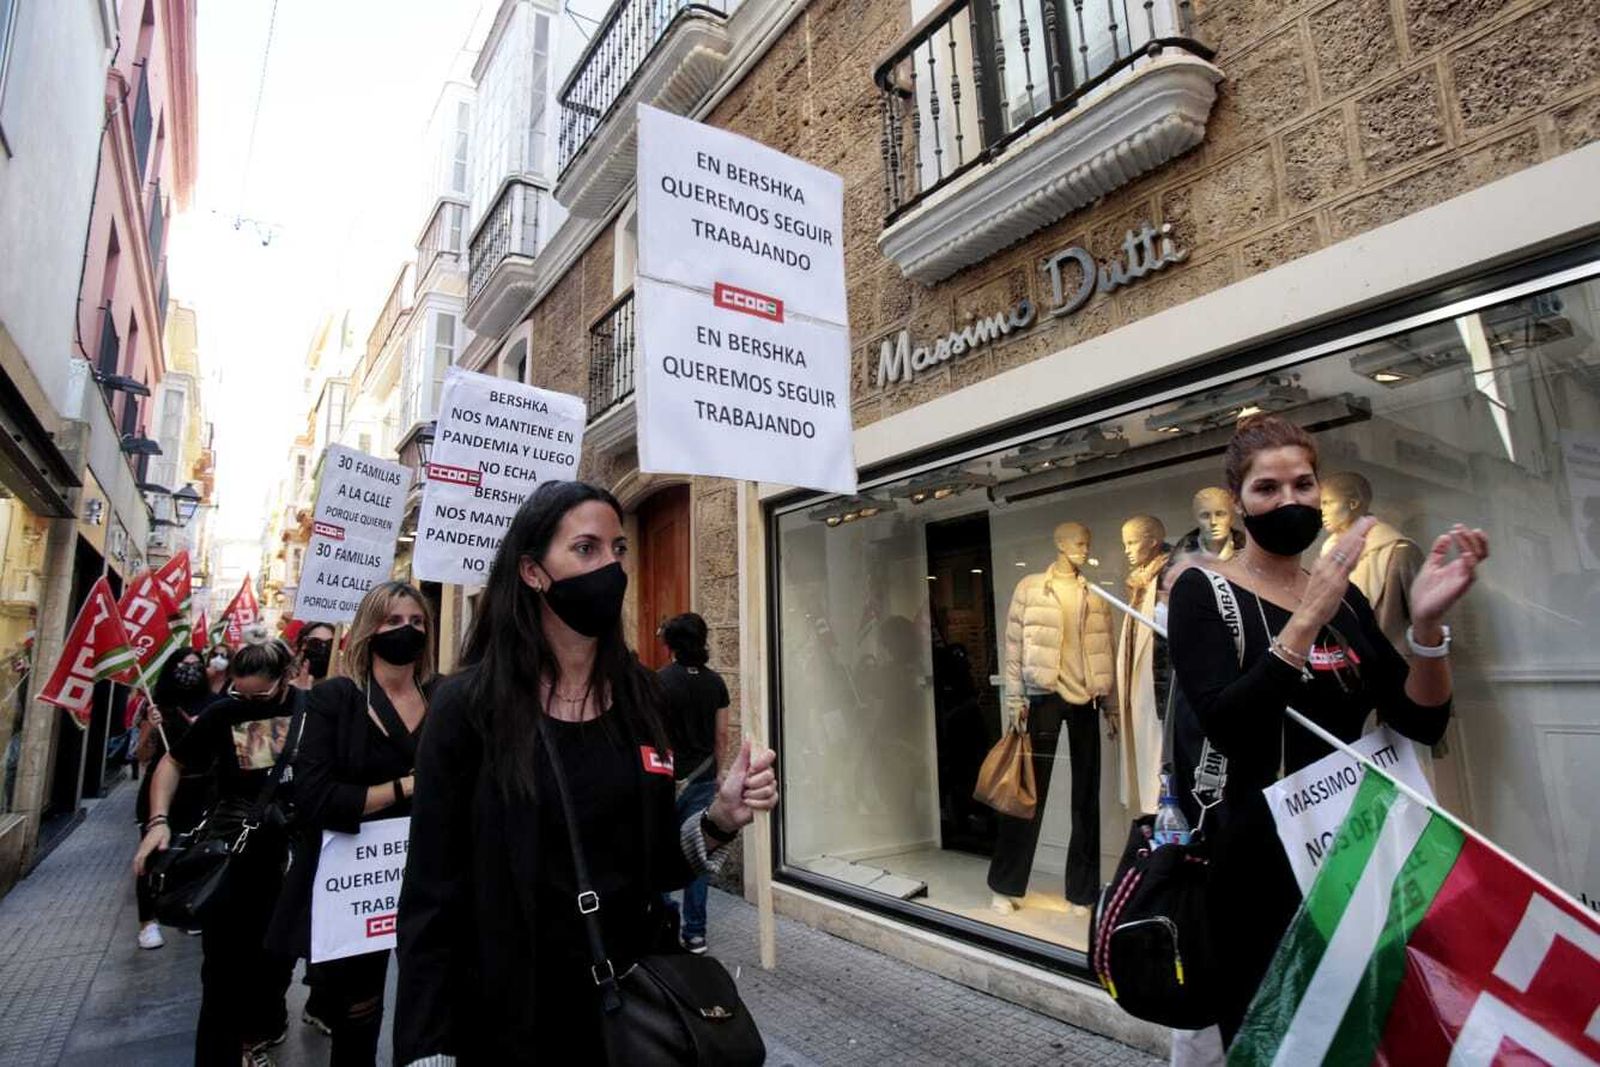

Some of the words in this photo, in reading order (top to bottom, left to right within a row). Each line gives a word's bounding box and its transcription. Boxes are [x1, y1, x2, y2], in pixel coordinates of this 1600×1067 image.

[697, 152, 720, 175] EN
[727, 163, 805, 205] BERSHKA
[661, 175, 769, 225] QUEREMOS
[774, 213, 832, 246] SEGUIR
[692, 219, 811, 271] TRABAJANDO
[876, 298, 1037, 387] Massimo
[1043, 222, 1190, 318] Dutti
[697, 326, 721, 348] EN
[728, 333, 807, 368] BERSHKA
[663, 356, 772, 395] QUEREMOS
[777, 380, 836, 408] SEGUIR
[490, 390, 548, 414] BERSHKA
[451, 407, 481, 424] NOS
[486, 414, 554, 439] MANTIENE
[557, 430, 574, 444] EN
[694, 400, 816, 439] TRABAJANDO
[442, 429, 518, 456] PANDEMIA
[522, 445, 531, 457] Y
[533, 449, 575, 466] LUEGO
[338, 455, 353, 470] 30
[356, 462, 401, 486] FAMILIAS
[478, 460, 500, 475] NO
[504, 465, 537, 481] ECHA
[338, 483, 346, 497] A
[349, 486, 361, 501] LA
[363, 490, 392, 508] CALLE
[474, 486, 526, 505] BERSHK
[326, 505, 359, 522] PORQUE
[360, 513, 393, 530] QUIEREN
[435, 505, 466, 521] NOS
[470, 510, 512, 528] MANT
[316, 542, 332, 558] 30
[335, 548, 381, 568] FAMILIAS
[462, 557, 485, 572] NO
[316, 572, 324, 585] A
[326, 573, 339, 587] LA
[342, 576, 372, 591] CALLE
[303, 596, 338, 610] PORQUE
[339, 600, 360, 612] QUIE
[1285, 767, 1357, 817] MASSIMO
[1358, 745, 1400, 773] TTI
[356, 844, 377, 860] EN
[325, 866, 404, 893] QUEREM
[352, 896, 399, 916] TRAB
